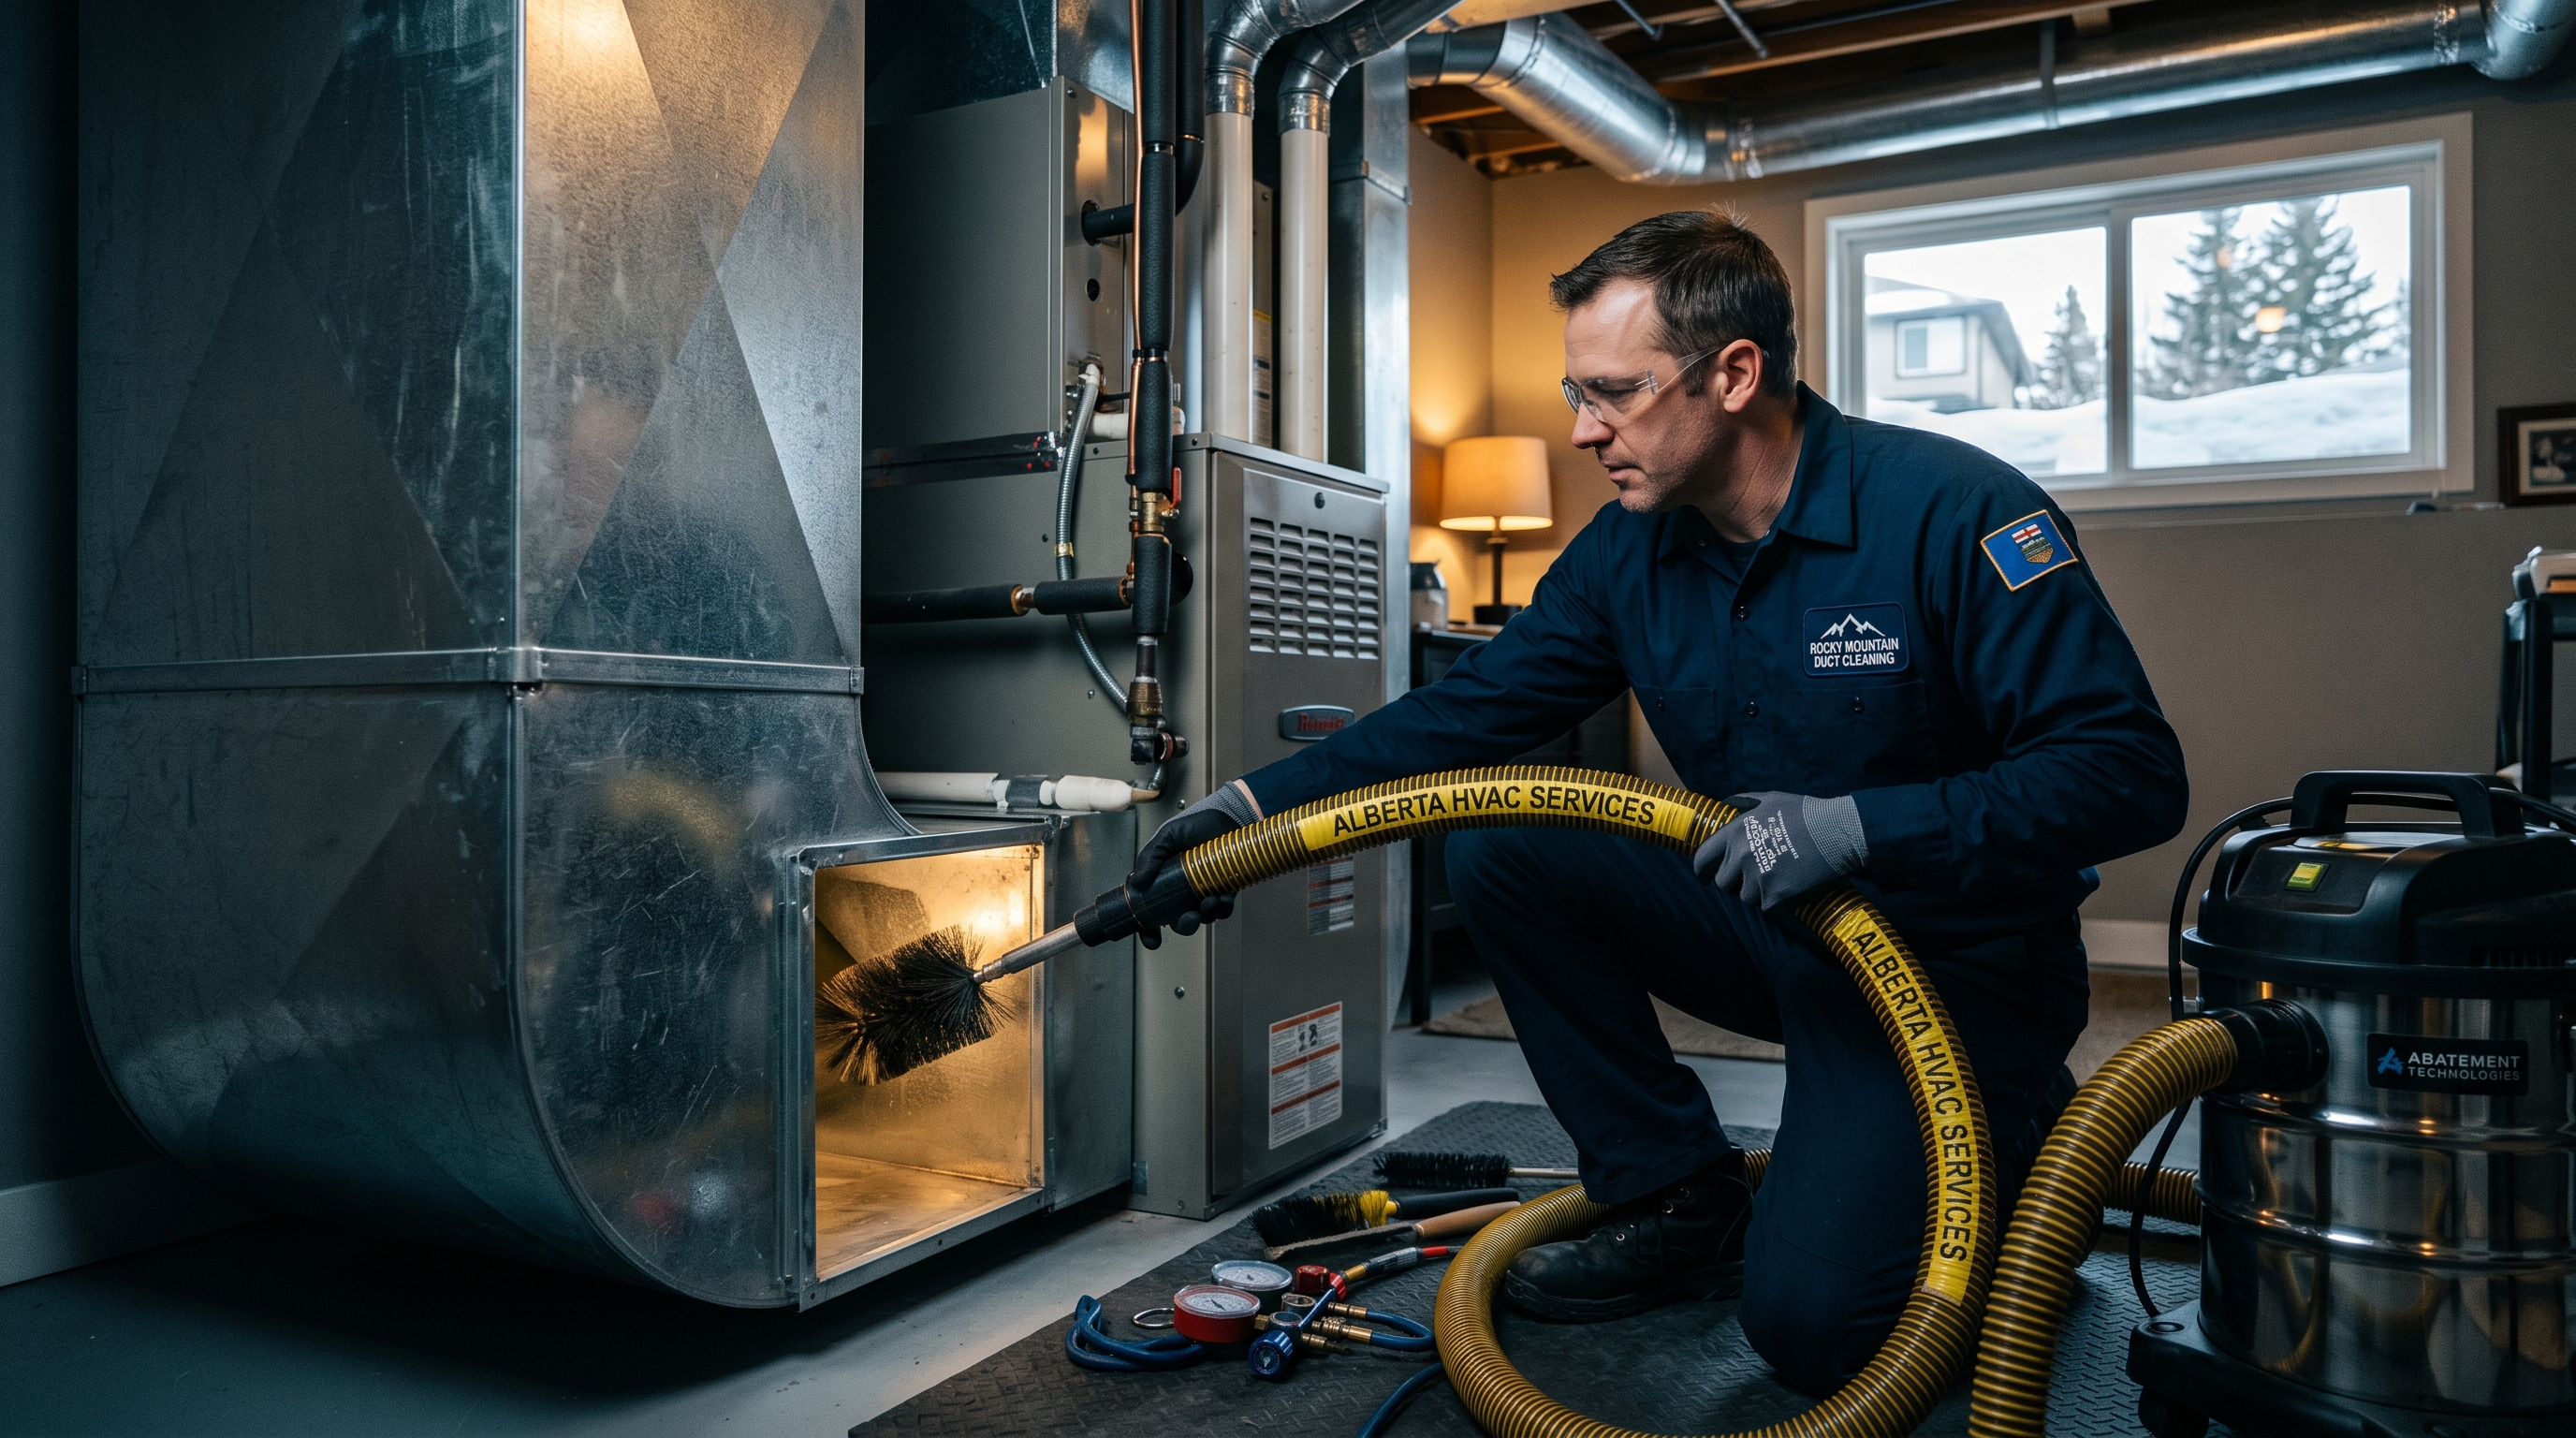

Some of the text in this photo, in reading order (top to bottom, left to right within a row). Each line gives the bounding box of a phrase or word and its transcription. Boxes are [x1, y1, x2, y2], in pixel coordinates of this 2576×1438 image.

[1810, 638, 1899, 654] ROCKY MOUNTAIN
[1814, 652, 1895, 668] DUCT CLEANING
[1333, 785, 1656, 837] ALBERTA HVAC SERVICES
[2408, 1051, 2520, 1068] ABATEMENT
[2408, 1066, 2520, 1080] TECHNOLOGIES
[1852, 931, 1972, 1262] ALBERTA HVAC SERVICES
